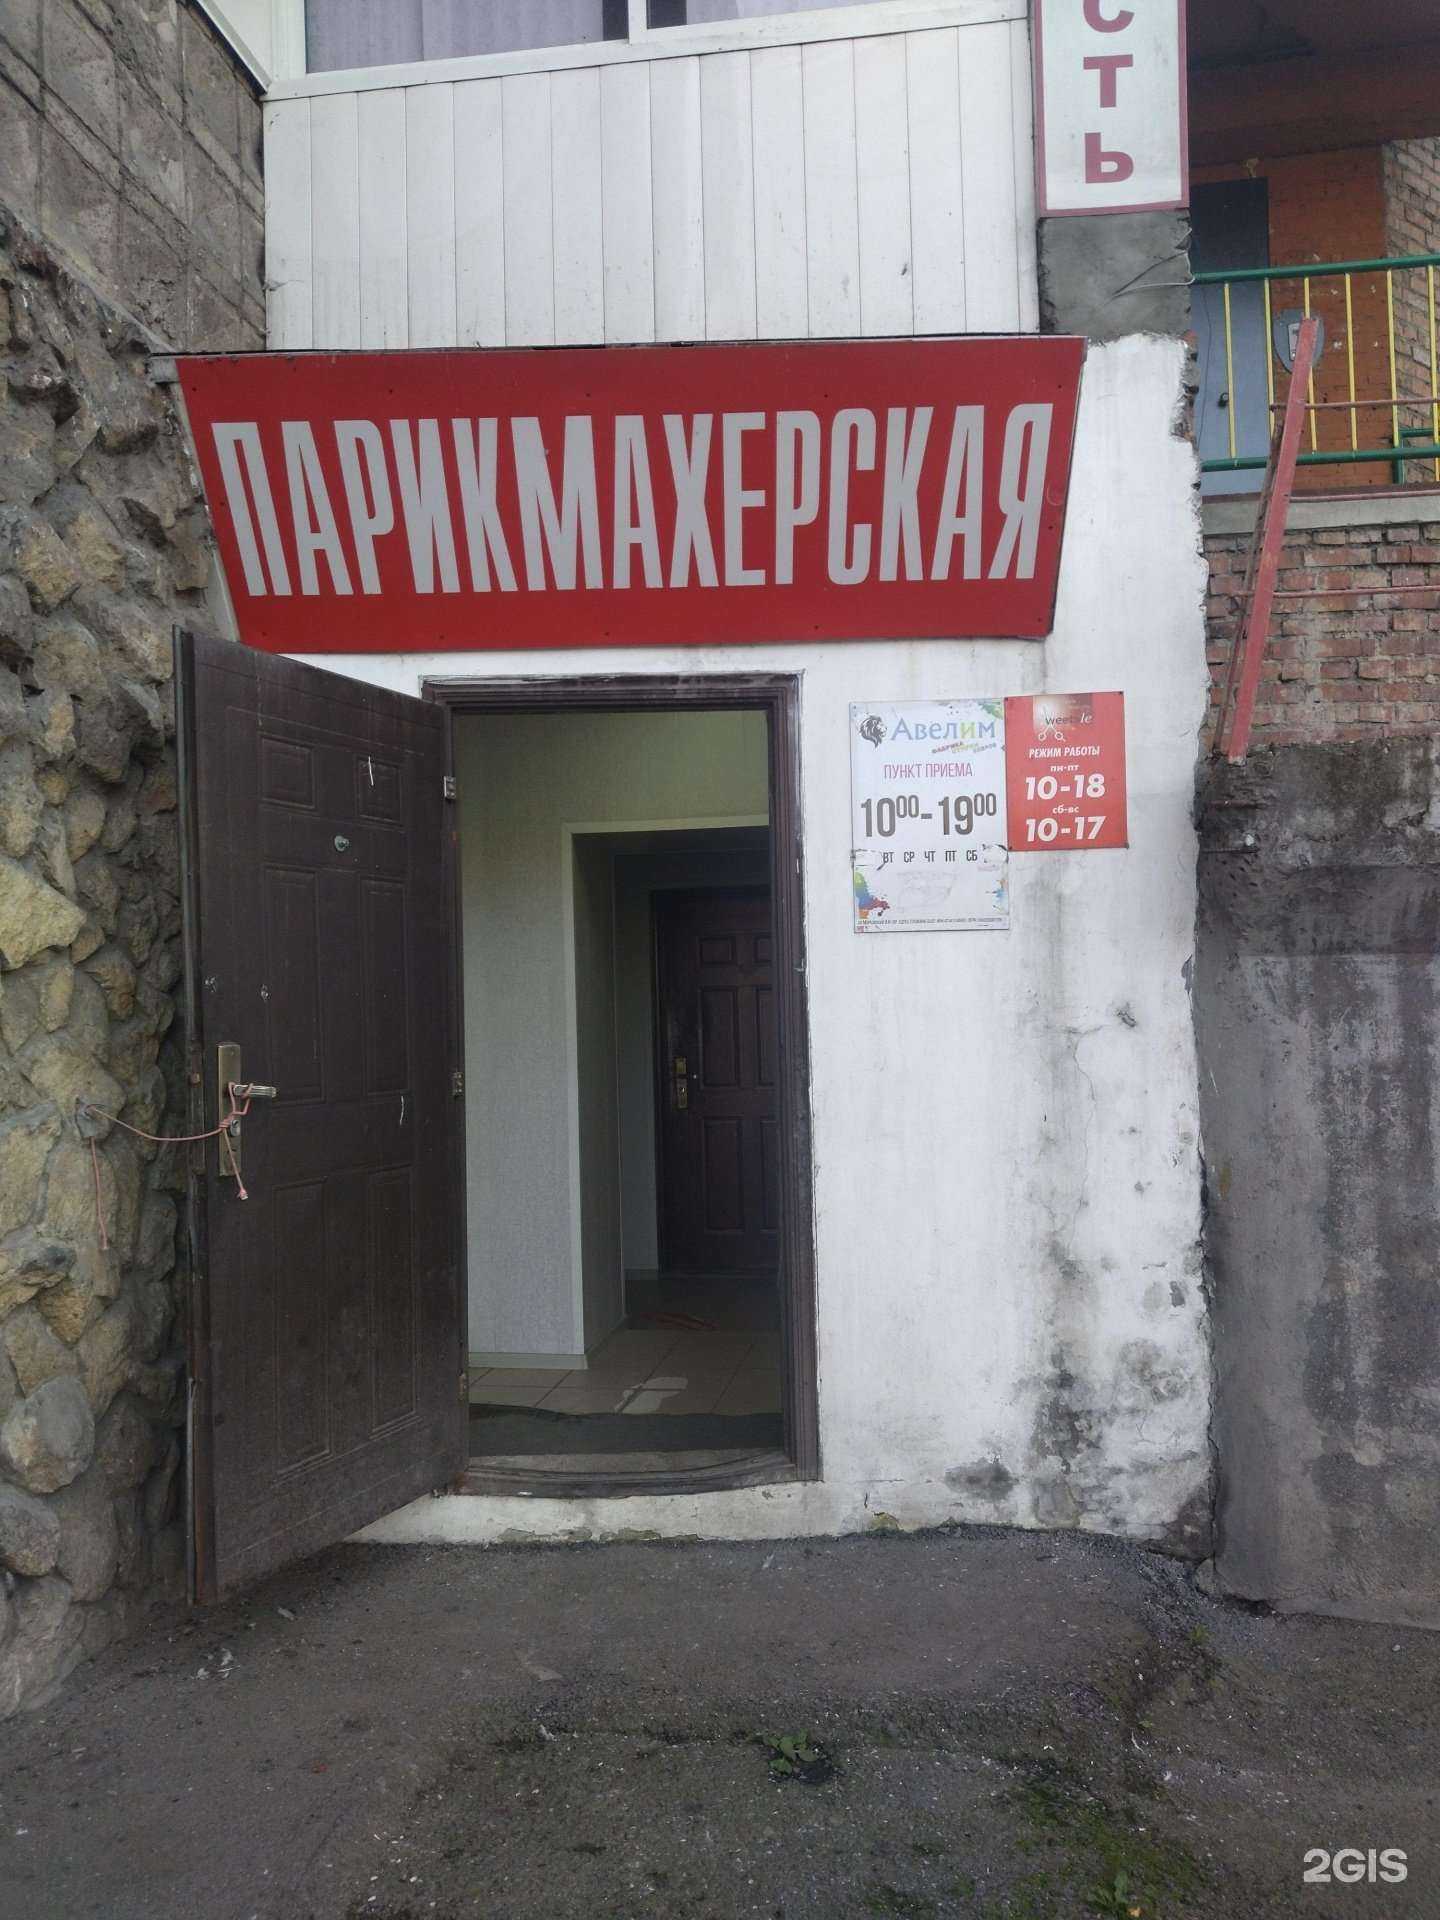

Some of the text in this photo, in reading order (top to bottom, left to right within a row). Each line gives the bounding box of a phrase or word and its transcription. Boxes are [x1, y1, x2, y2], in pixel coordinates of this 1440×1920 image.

[212, 402, 1054, 597] ПАРИКМАХЕРСКАЯ
[890, 718, 996, 741] Авелим
[1029, 745, 1101, 759] РЕЖИМ РАБОТЫ
[883, 762, 974, 779] ПУНКТ ПРИЕМА
[1050, 764, 1080, 772] пн-пт
[1025, 772, 1106, 801] 10-18
[1052, 804, 1080, 814] сб-вс
[1025, 815, 1107, 843] 10-17
[882, 849, 978, 864] ВТ СР ЧТ ПТ СБ
